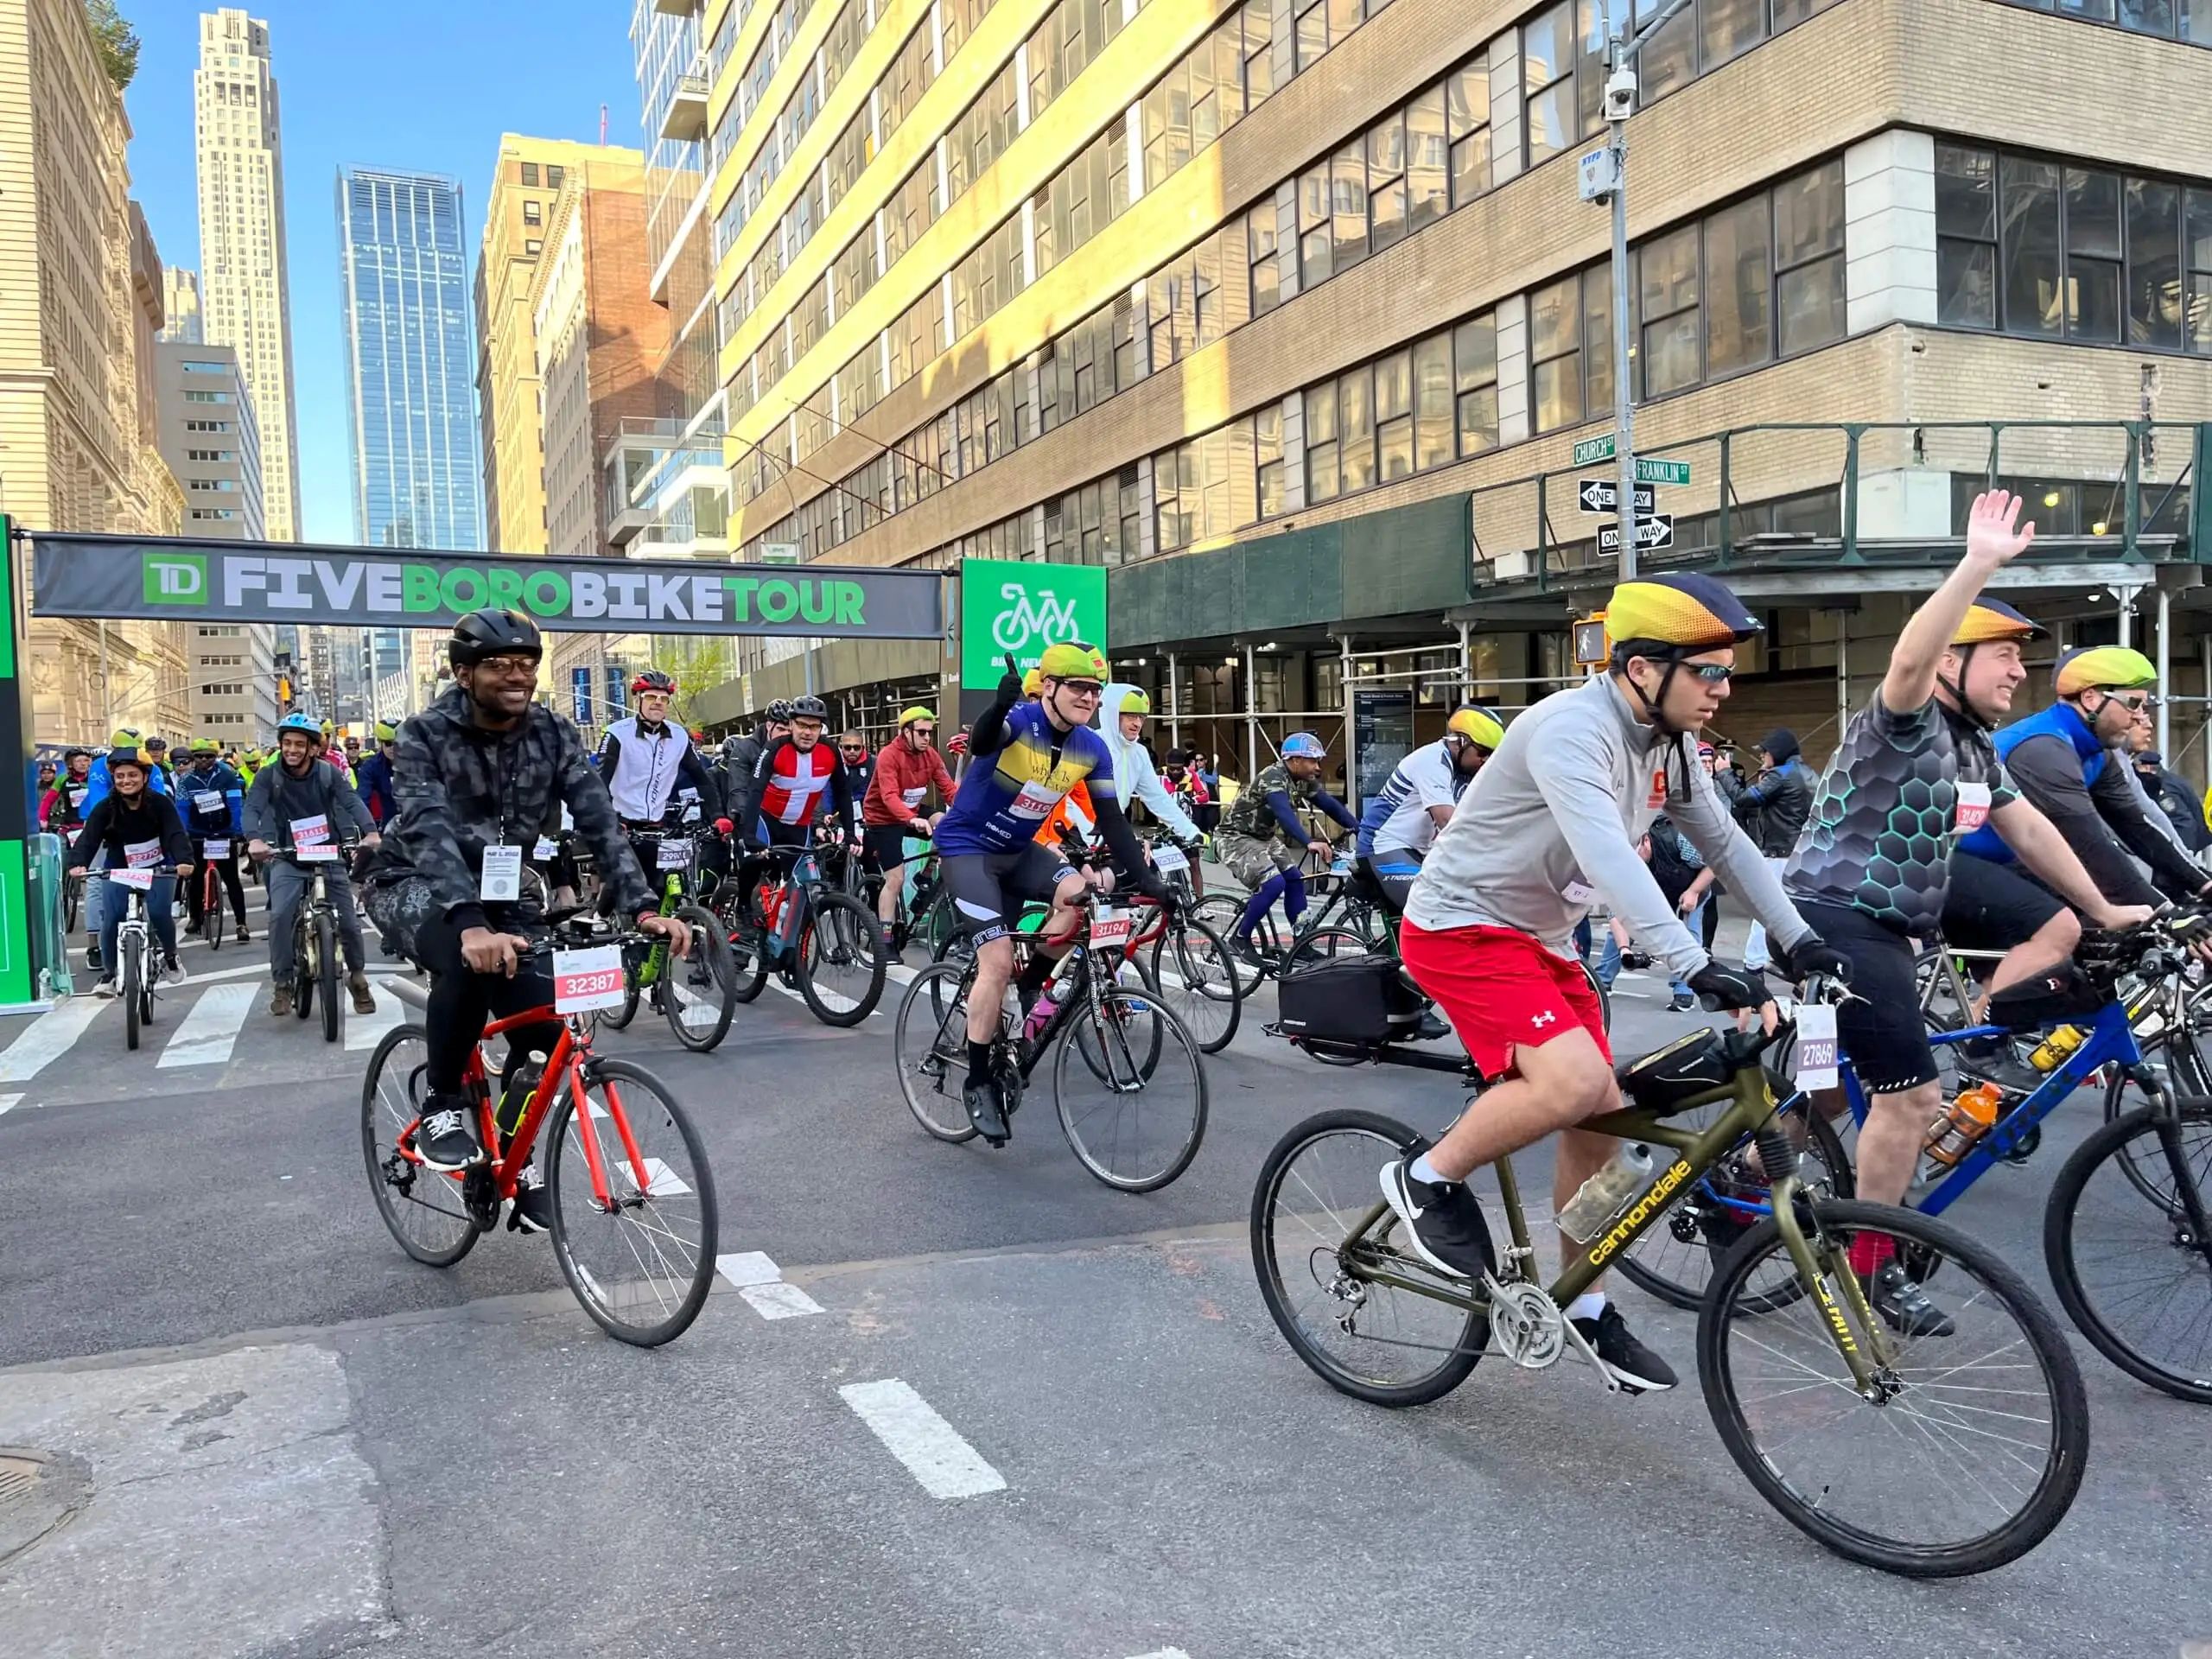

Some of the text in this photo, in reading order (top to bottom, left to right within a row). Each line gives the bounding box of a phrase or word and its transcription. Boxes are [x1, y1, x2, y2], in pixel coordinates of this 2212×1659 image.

[1575, 437, 1614, 463] CHURCH ST
[1637, 461, 1688, 481] FRANKLIN ST
[1587, 491, 1648, 505] ONE AY
[1604, 525, 1663, 544] ON WAY
[149, 562, 200, 594] TD
[753, 748, 769, 779] DENMARK
[985, 822, 1012, 839] ROMED
[1096, 923, 1124, 937] 31194
[566, 974, 615, 995] 32387
[1803, 1044, 1833, 1066] 27869
[1589, 1160, 1691, 1266] cannondale
